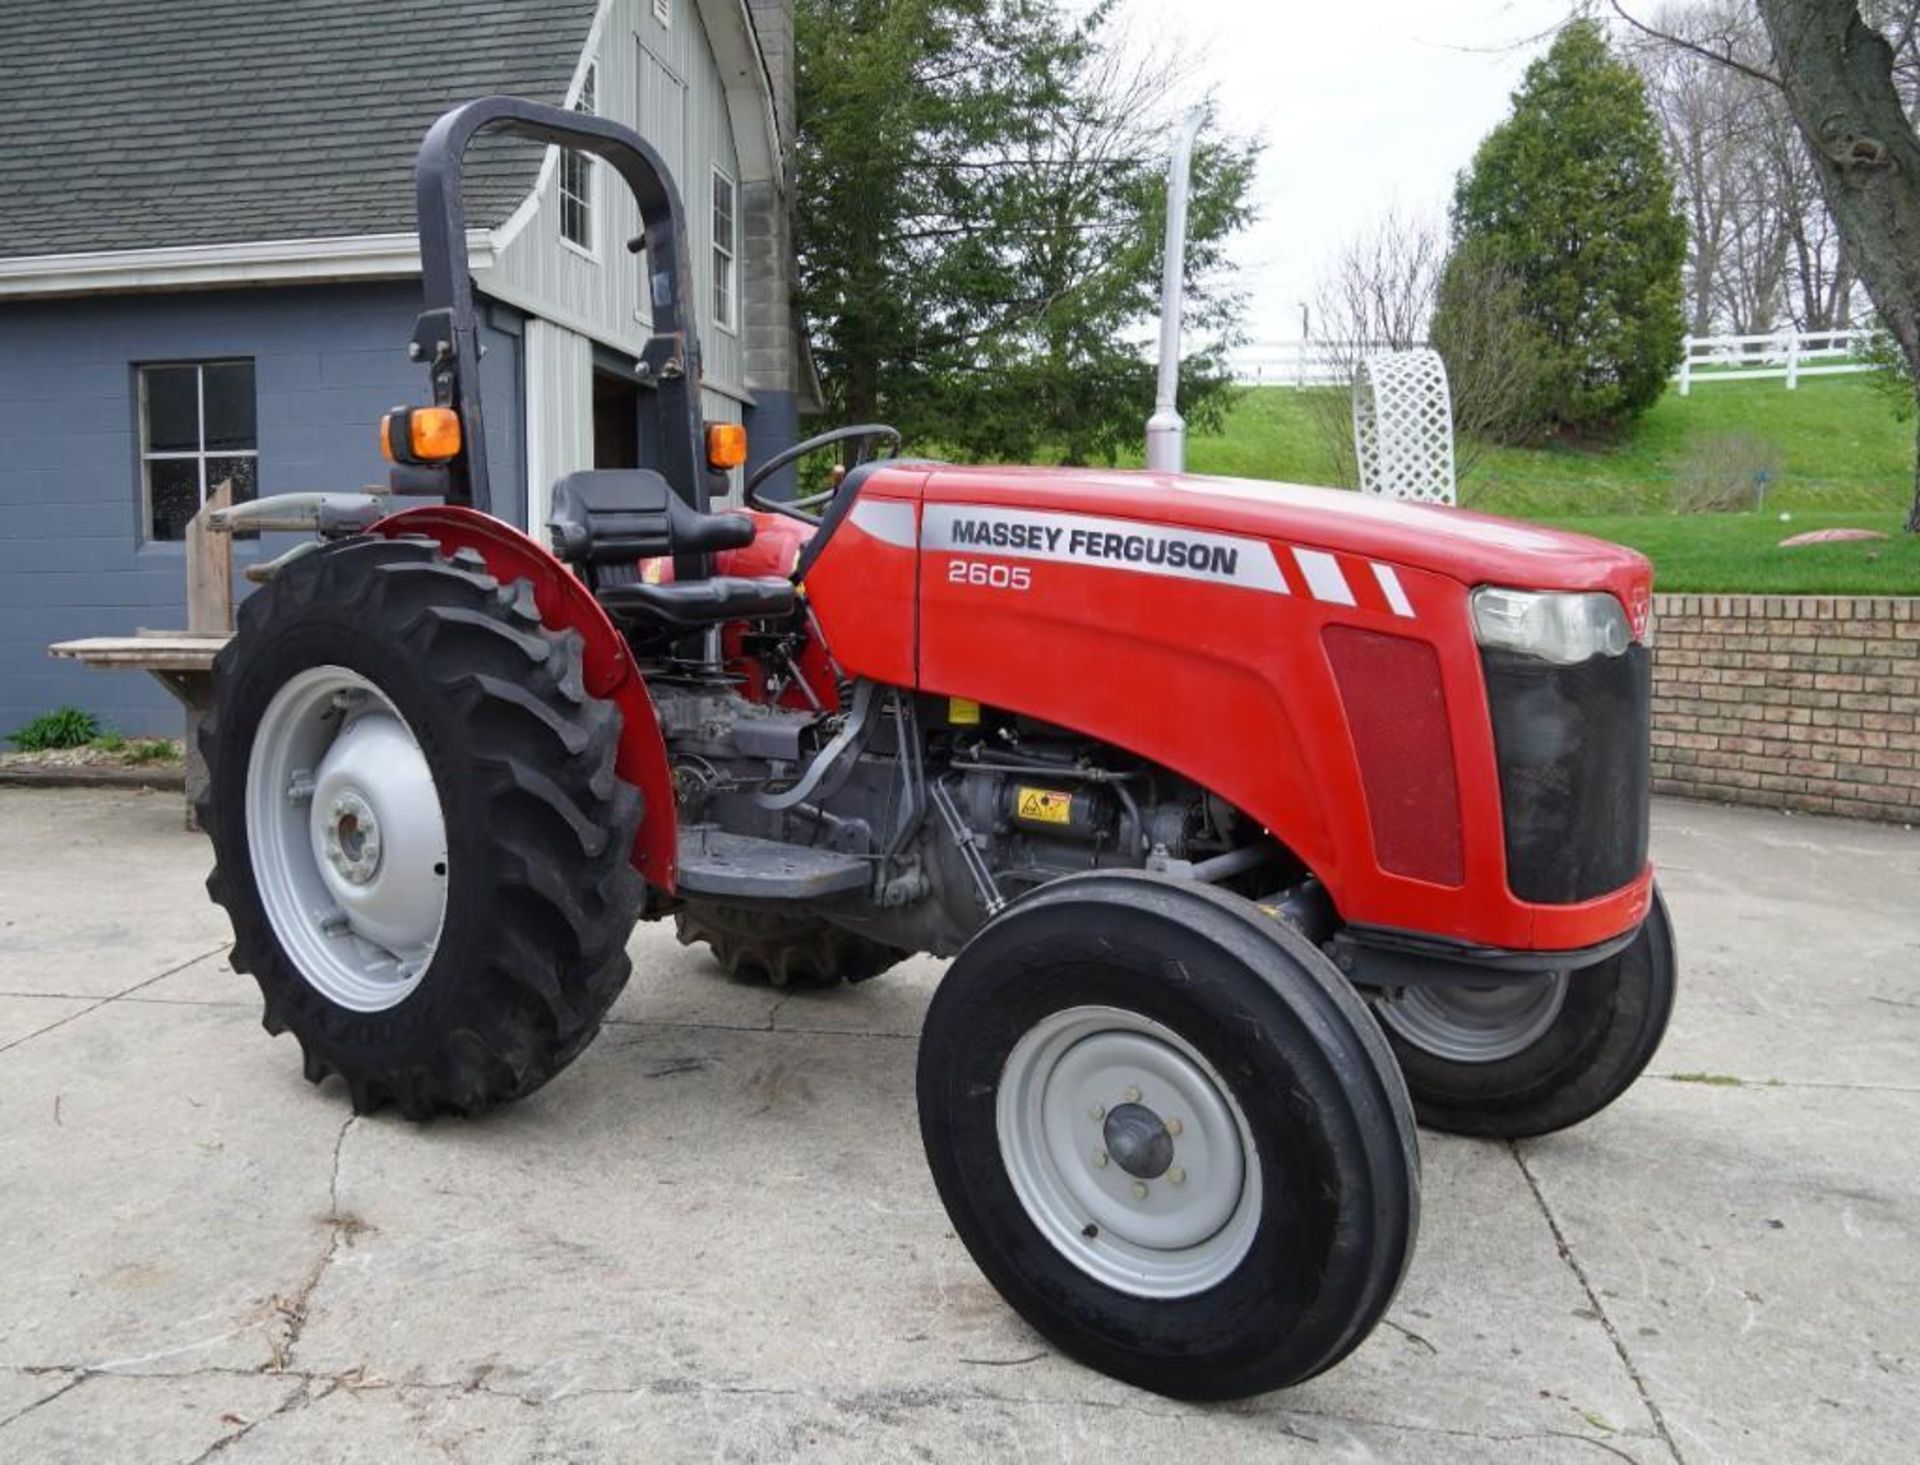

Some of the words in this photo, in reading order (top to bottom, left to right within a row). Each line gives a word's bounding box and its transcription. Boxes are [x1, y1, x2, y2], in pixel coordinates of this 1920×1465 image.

[952, 519, 1063, 551] MASSEY
[1069, 530, 1238, 574] FERGUSON
[949, 560, 1031, 590] 2605
